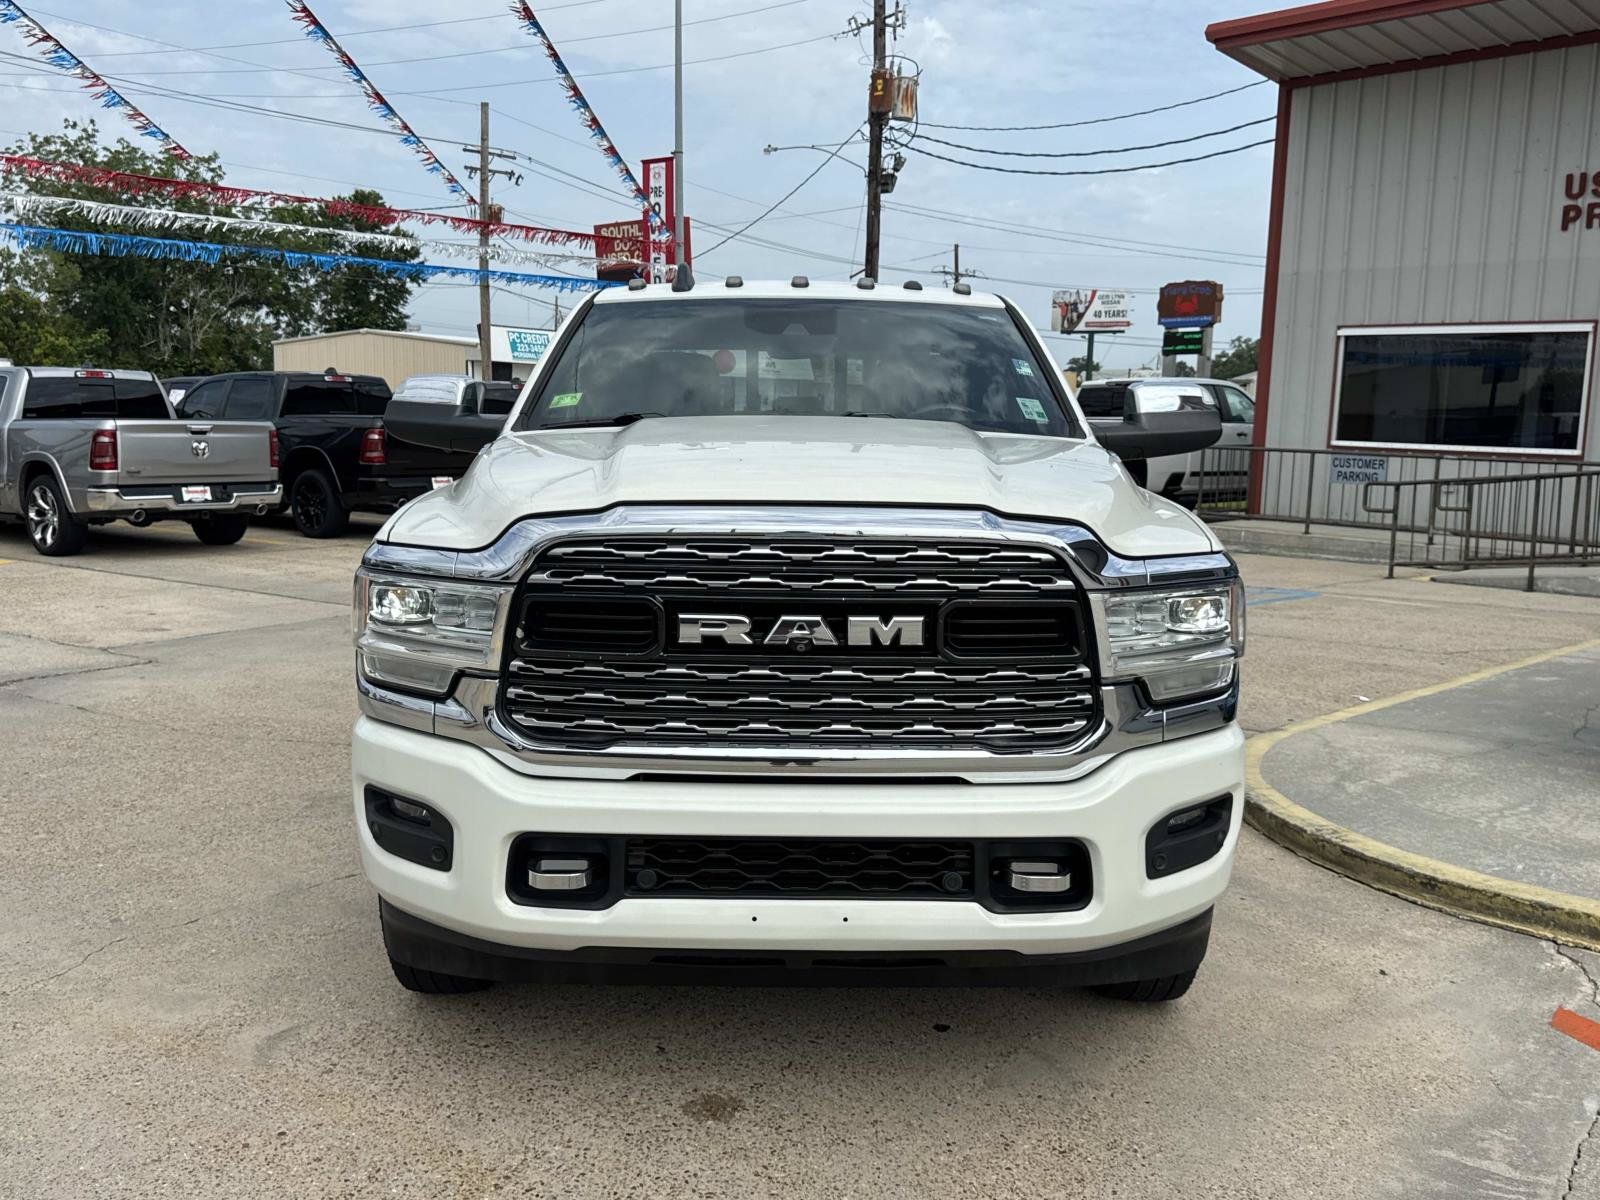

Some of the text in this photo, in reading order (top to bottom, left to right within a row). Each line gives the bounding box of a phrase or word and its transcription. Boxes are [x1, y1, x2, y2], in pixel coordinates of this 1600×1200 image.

[600, 224, 643, 238] SOUTHL
[1093, 310, 1128, 318] 40 YEARS!
[508, 332, 548, 345] PC CREDIT
[1332, 457, 1385, 470] CUSTOMER
[1337, 470, 1379, 482] PARKING
[678, 613, 924, 646] RAM
